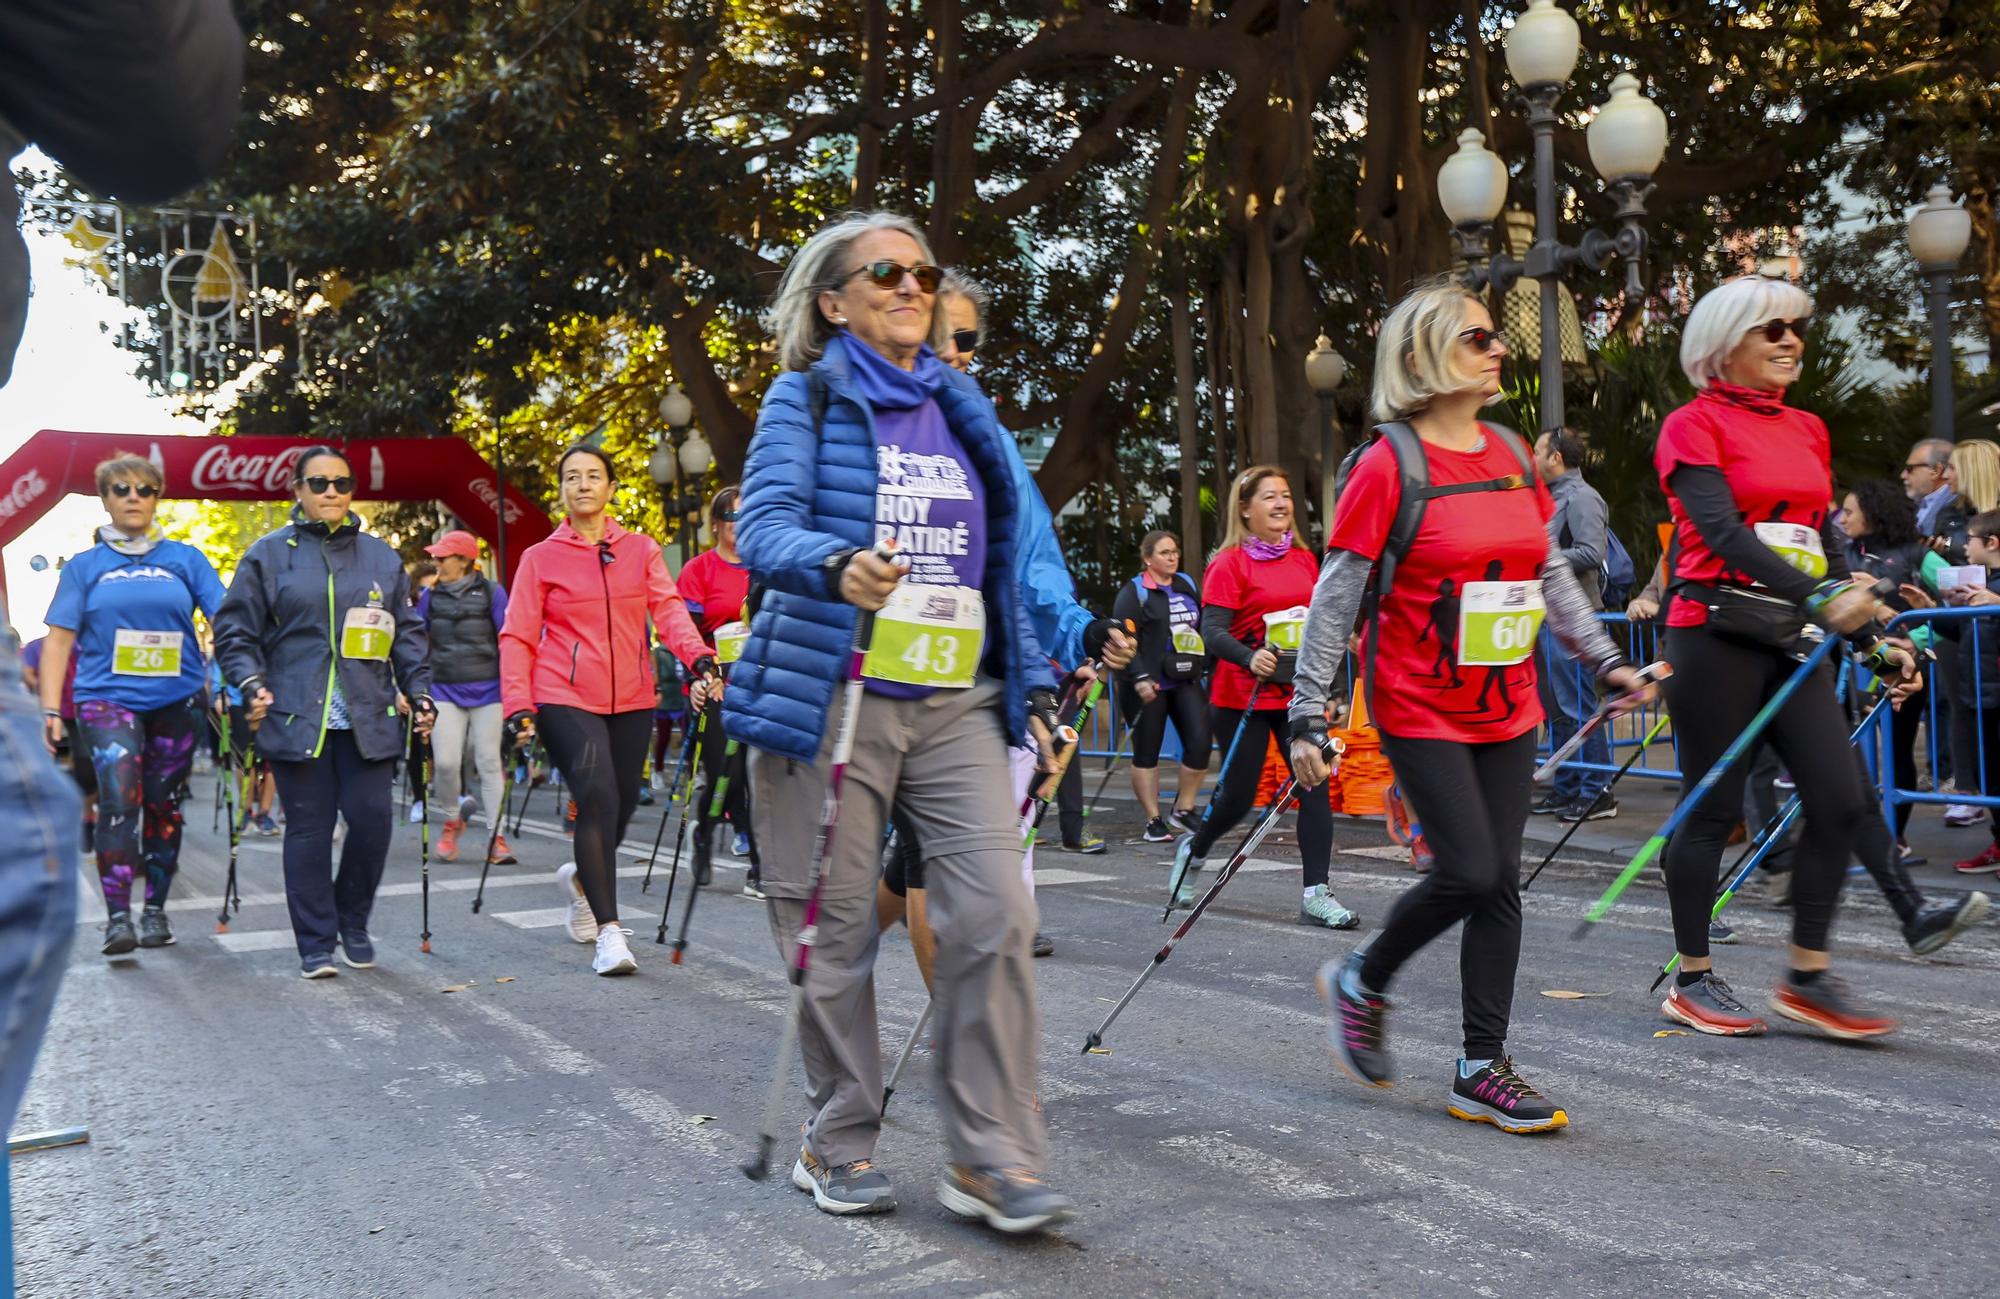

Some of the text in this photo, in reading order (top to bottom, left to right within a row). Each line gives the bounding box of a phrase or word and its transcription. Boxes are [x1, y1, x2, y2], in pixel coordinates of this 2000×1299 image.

[191, 444, 316, 491] Coca-Co
[876, 494, 932, 525] HOY
[1492, 615, 1532, 650] 60
[132, 649, 163, 668] 26
[902, 633, 960, 674] 43
